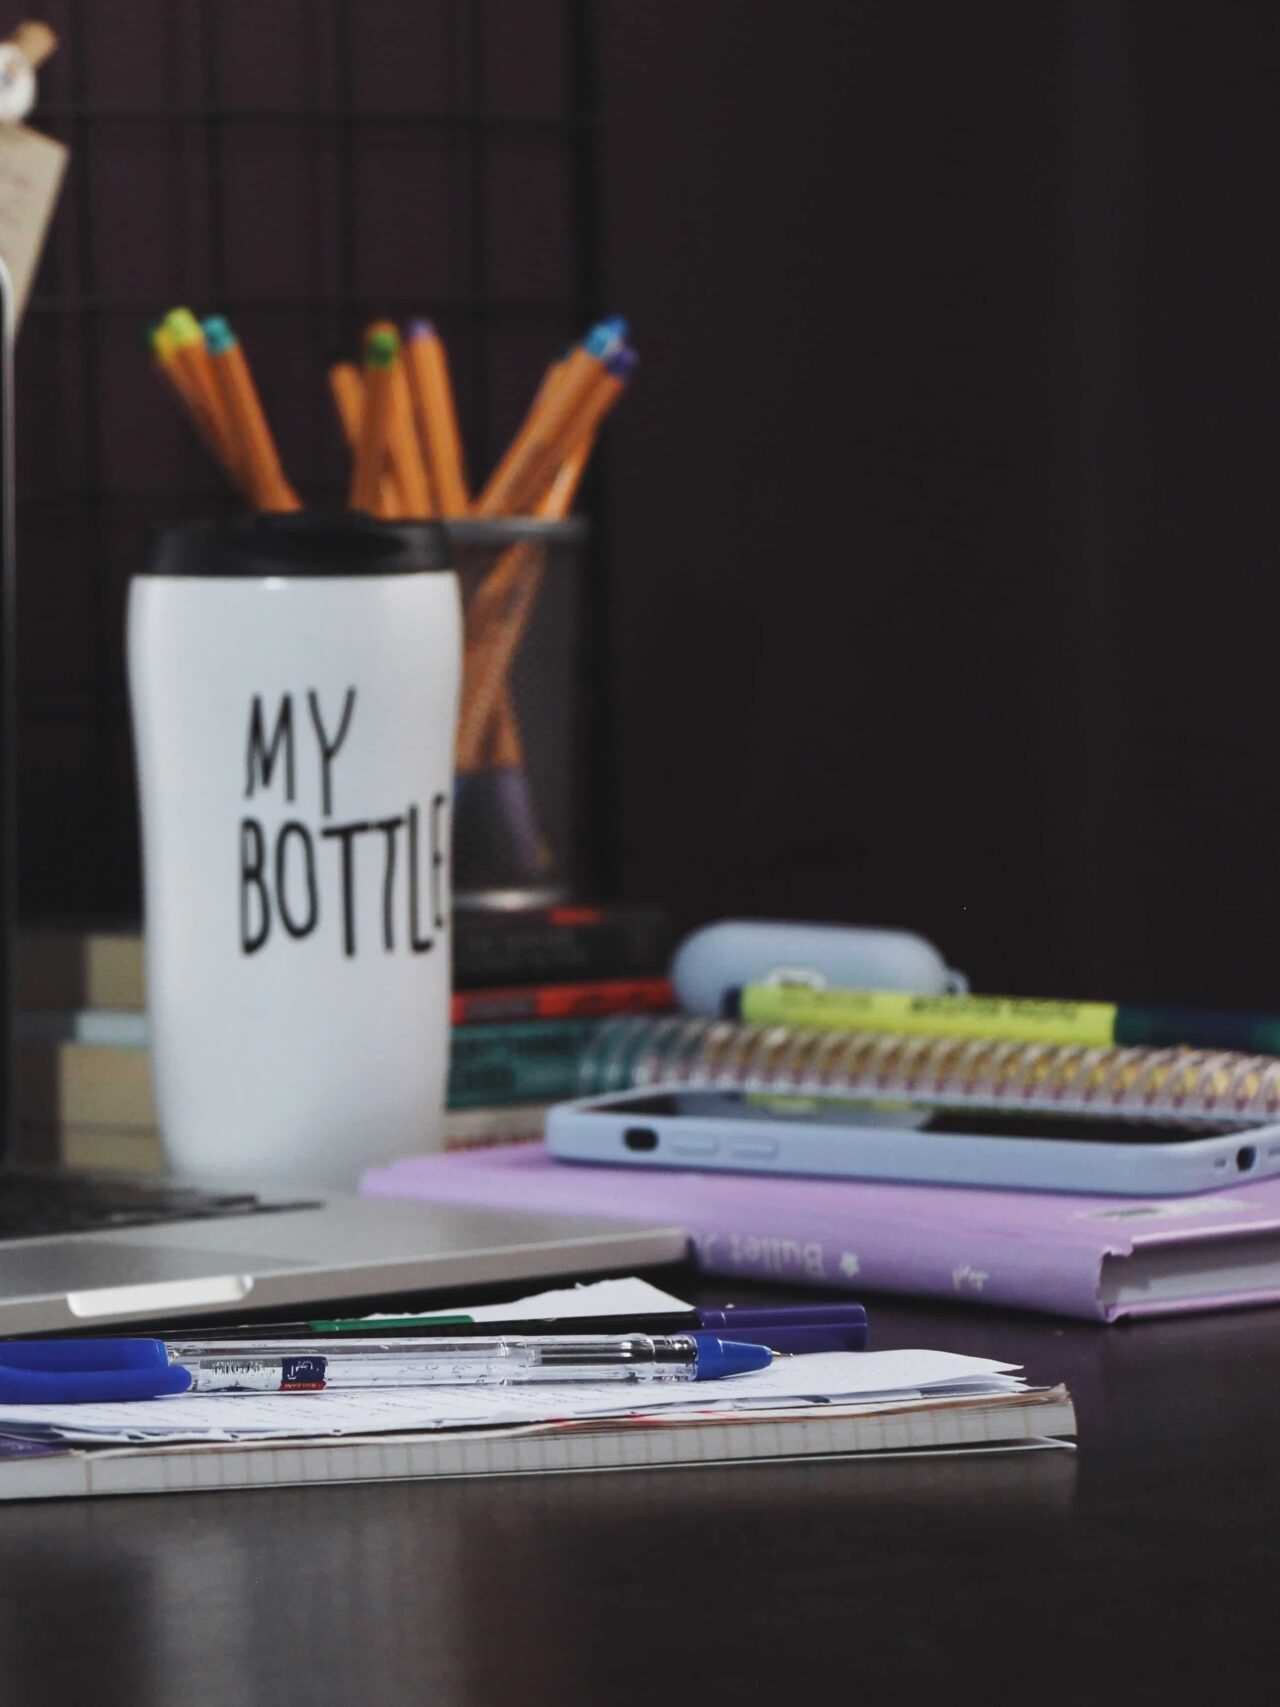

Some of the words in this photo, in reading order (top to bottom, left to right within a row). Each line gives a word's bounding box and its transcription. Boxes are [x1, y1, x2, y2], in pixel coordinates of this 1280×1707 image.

[245, 685, 356, 818] MY
[241, 793, 446, 958] BOTTLE
[730, 1232, 827, 1281] Bullet
